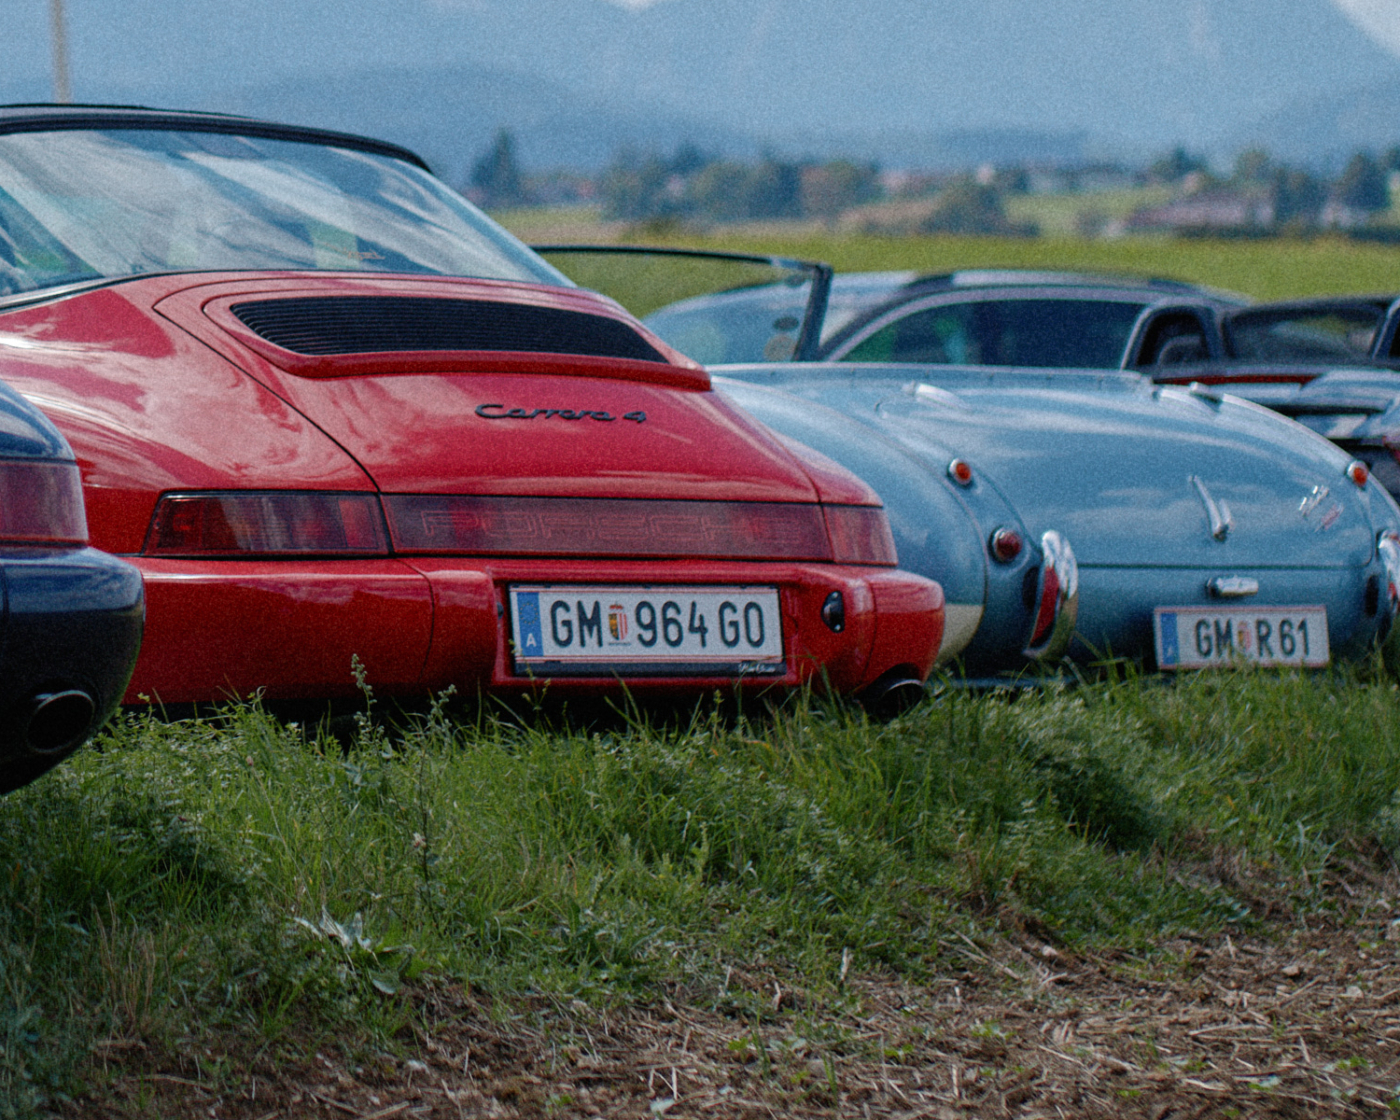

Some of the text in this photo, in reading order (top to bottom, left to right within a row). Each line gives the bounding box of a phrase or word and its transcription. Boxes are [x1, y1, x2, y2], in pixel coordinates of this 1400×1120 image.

[475, 403, 647, 424] Carrera 4
[550, 600, 604, 648] GM
[1195, 618, 1234, 658] GM
[525, 633, 538, 648] A
